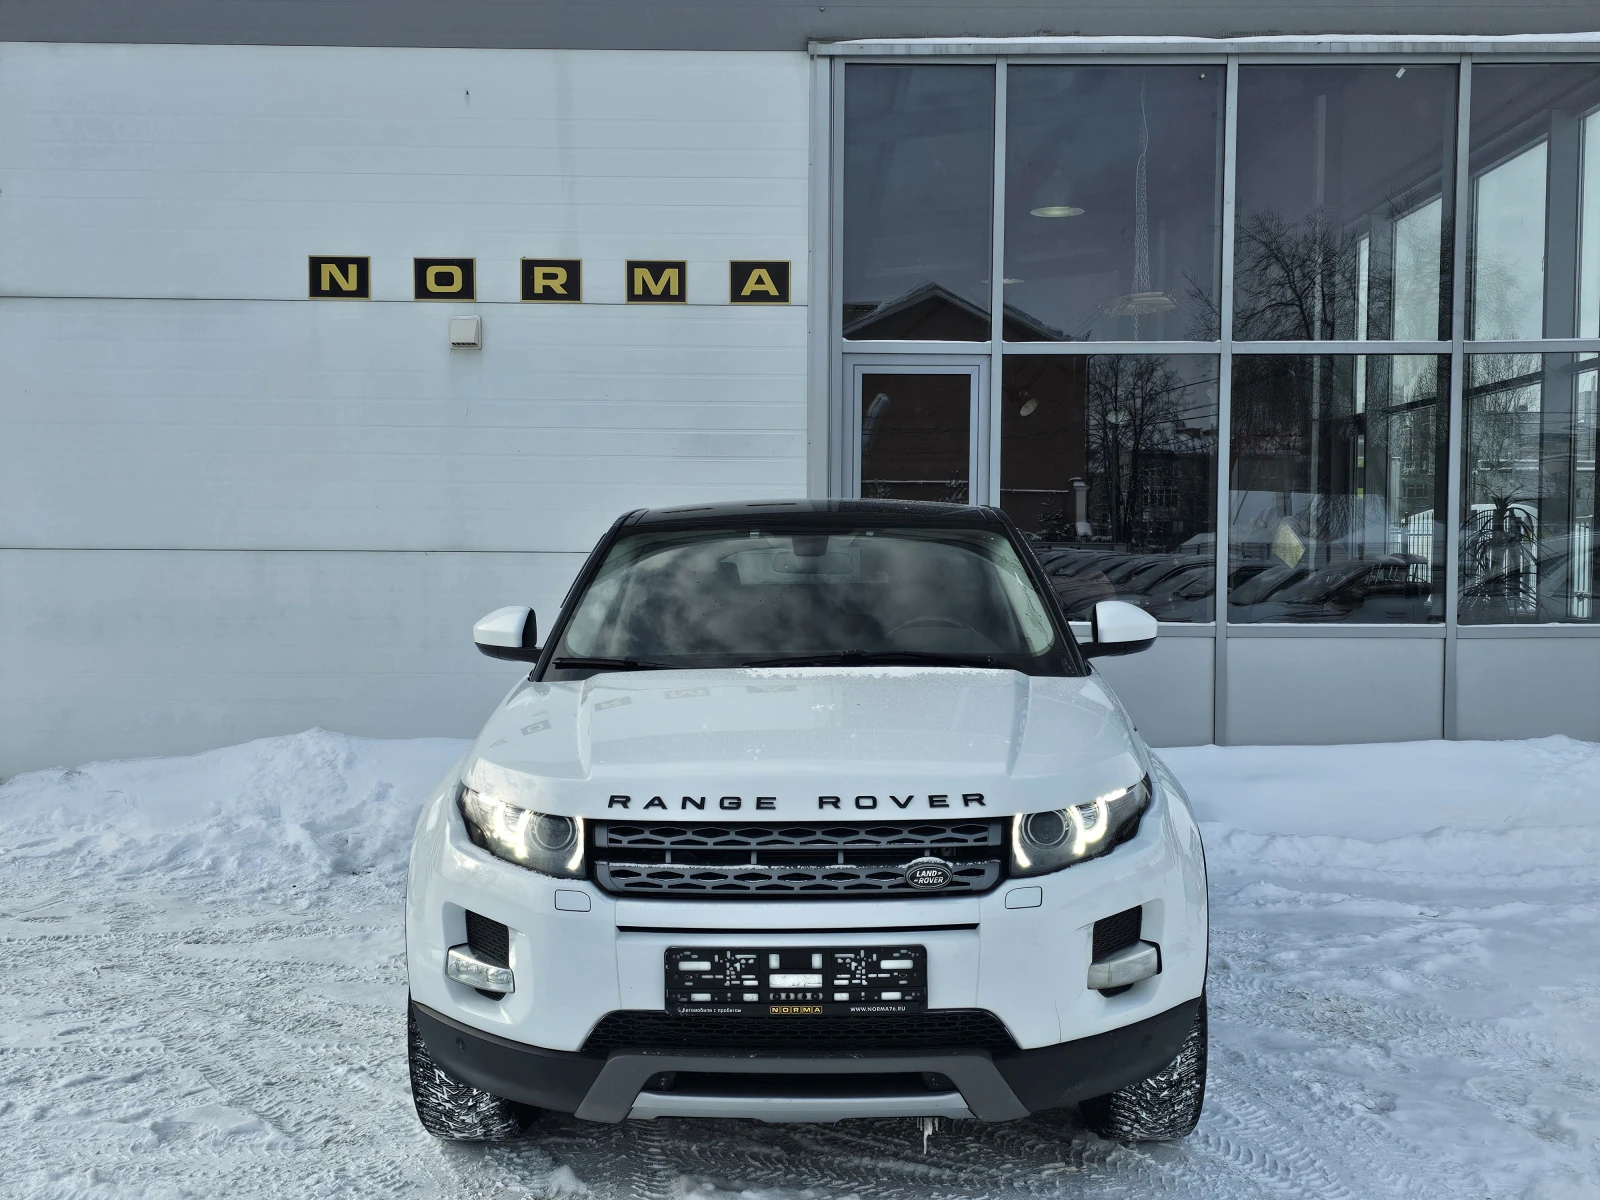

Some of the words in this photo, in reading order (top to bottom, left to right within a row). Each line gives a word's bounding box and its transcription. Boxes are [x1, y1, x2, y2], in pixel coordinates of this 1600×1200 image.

[320, 262, 780, 297] NORMA
[607, 794, 777, 811] RANGE
[818, 792, 987, 810] ROVER
[916, 870, 937, 878] LAND
[918, 876, 944, 884] ROVER
